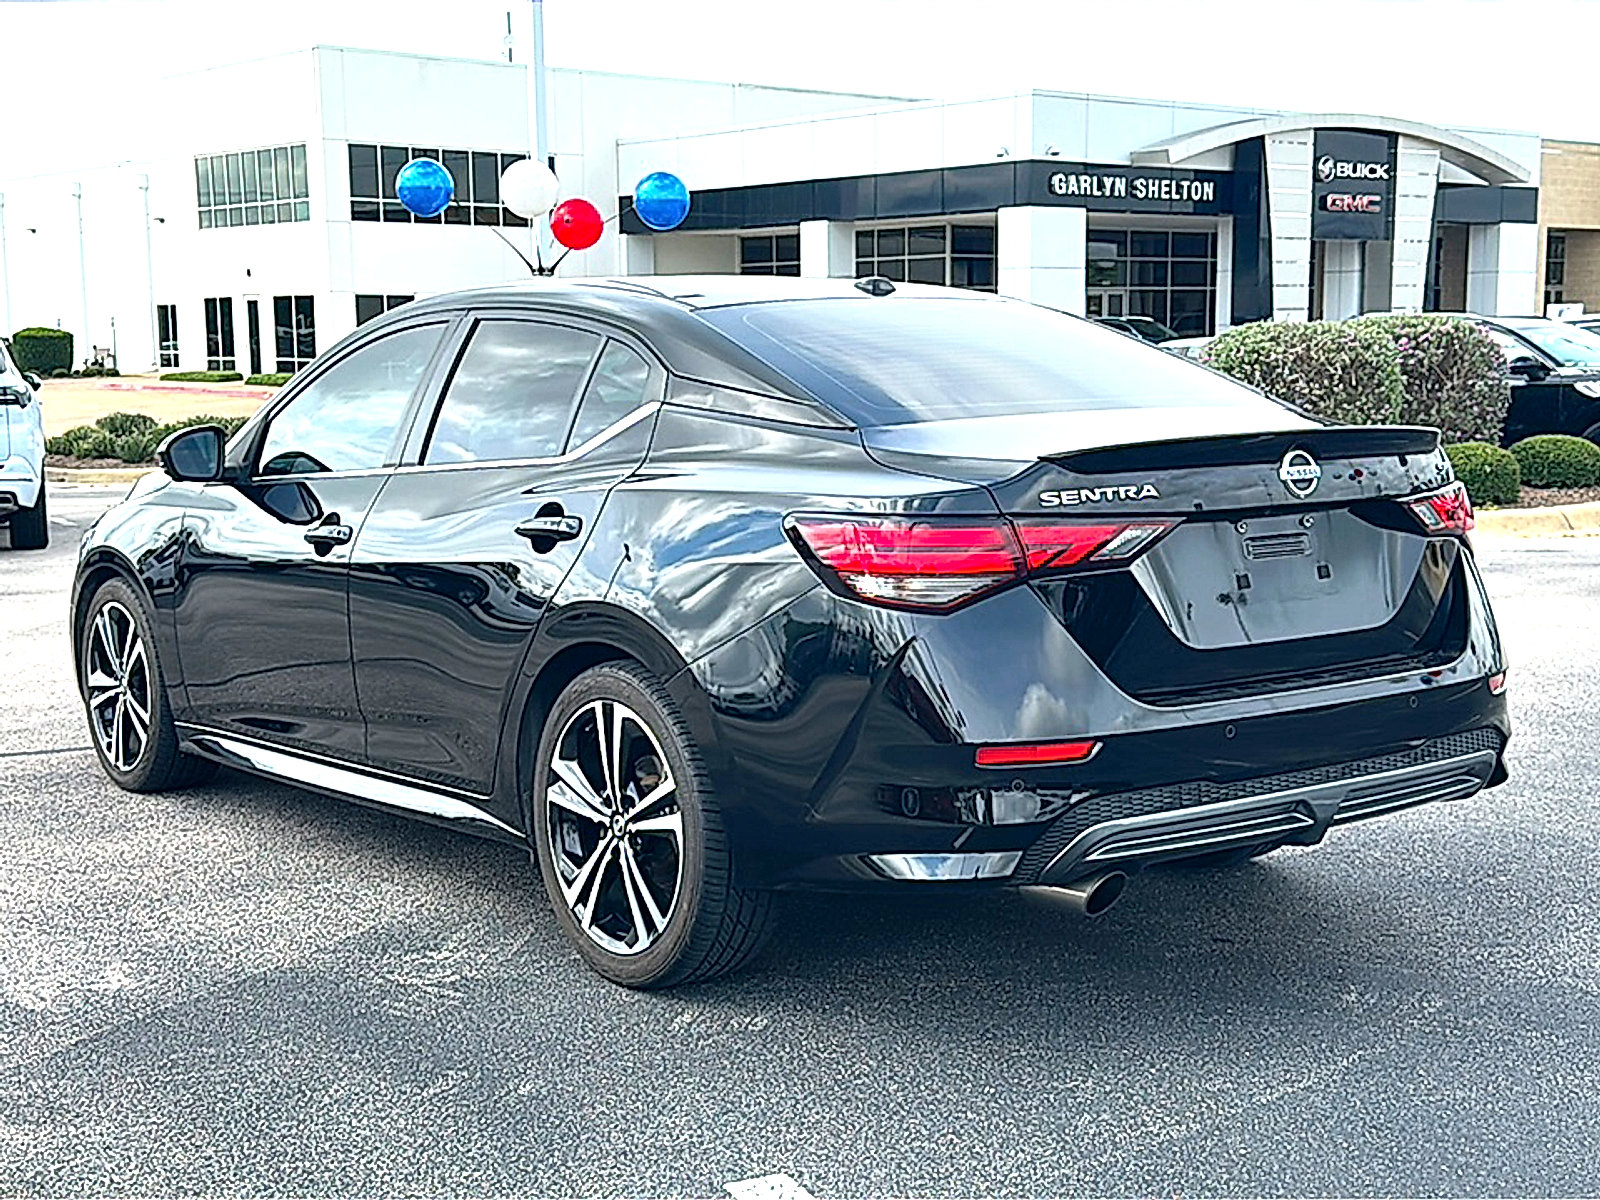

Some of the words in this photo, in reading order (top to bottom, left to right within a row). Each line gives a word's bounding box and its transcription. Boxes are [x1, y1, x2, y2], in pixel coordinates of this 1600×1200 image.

[1336, 161, 1390, 180] BUICK
[1051, 173, 1127, 198] GARLYN
[1133, 178, 1215, 201] SHELTON
[1326, 193, 1382, 213] GMC
[1039, 484, 1161, 507] SENTRA
